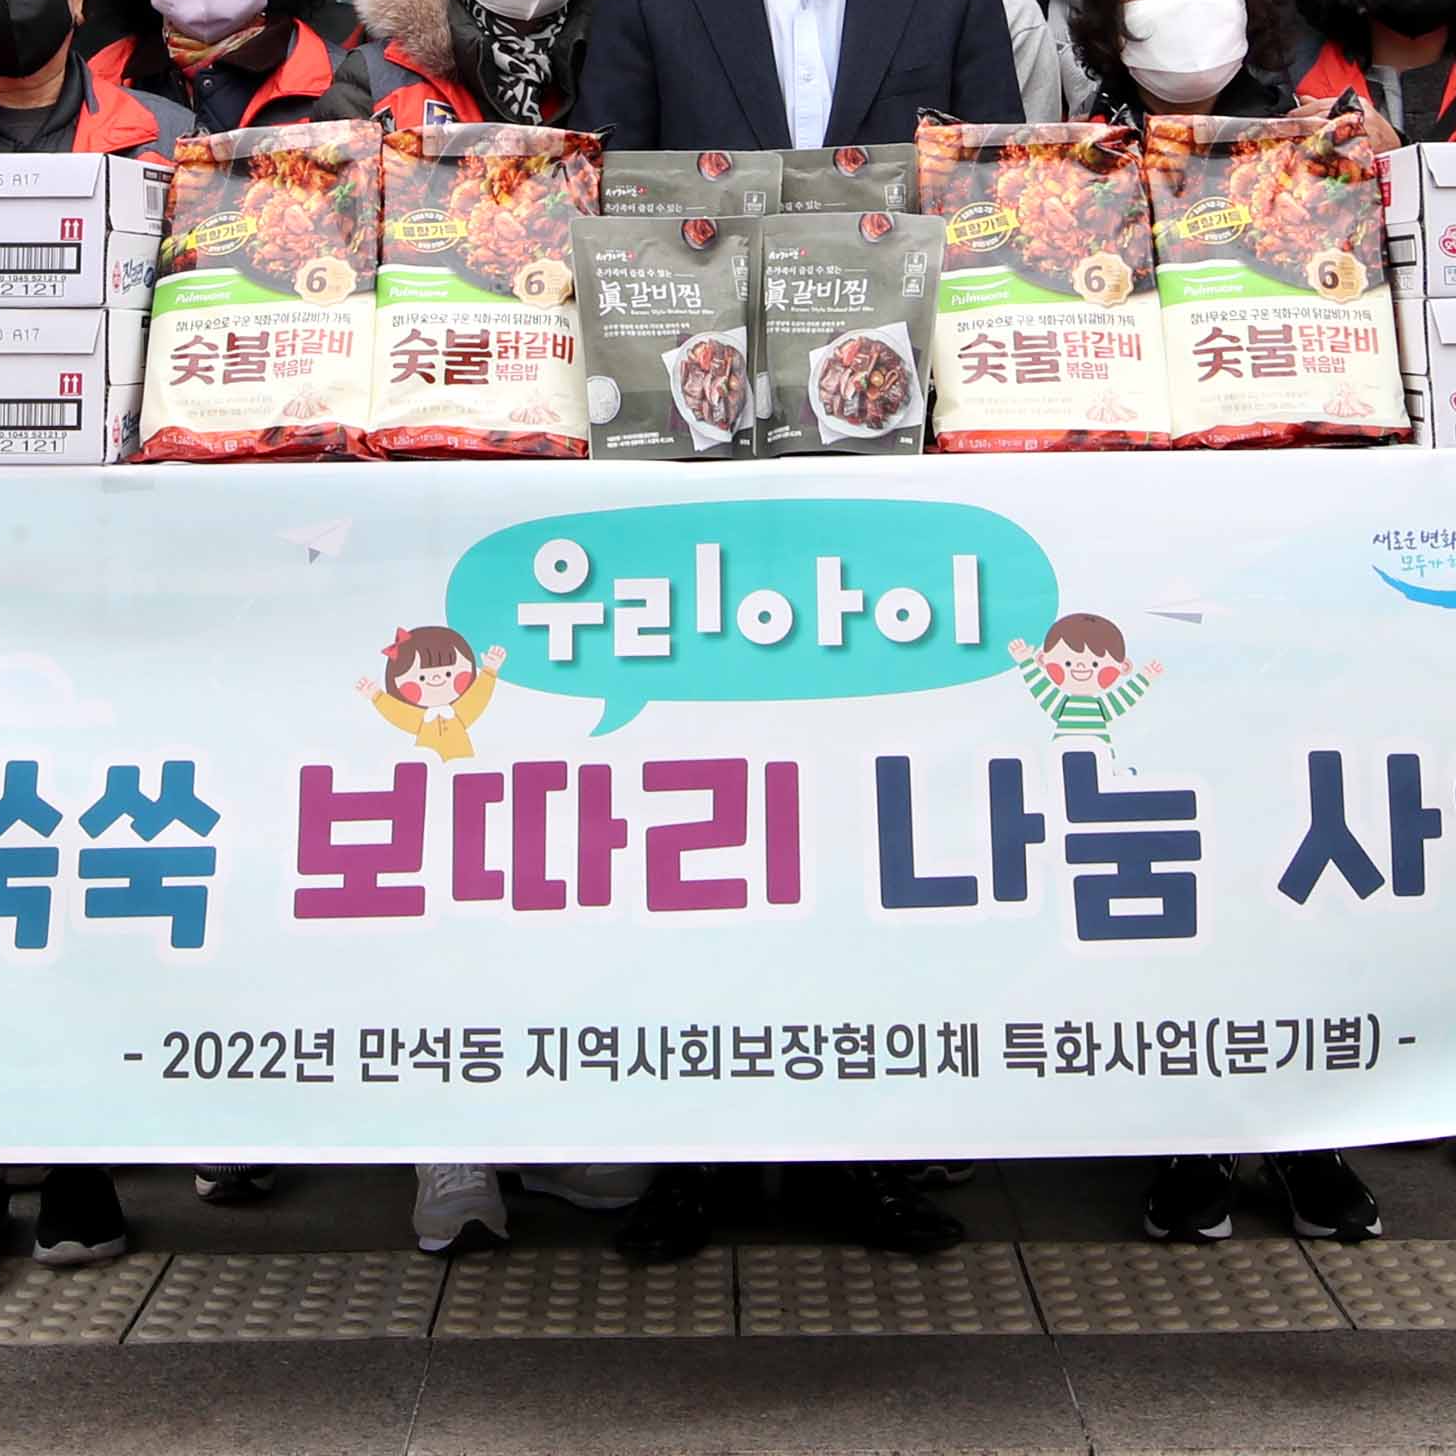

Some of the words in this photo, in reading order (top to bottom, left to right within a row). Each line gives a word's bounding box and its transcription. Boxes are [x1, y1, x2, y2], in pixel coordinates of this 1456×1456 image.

[306, 267, 327, 293] 6
[525, 270, 545, 295] 6
[1084, 265, 1105, 293] 6
[1318, 260, 1339, 289] 6
[169, 331, 271, 386] 숯불
[274, 328, 353, 358] 닭갈비
[389, 328, 493, 385] 숯불
[496, 330, 575, 365] 닭갈비
[957, 330, 1062, 385] 숯불
[1063, 330, 1142, 361] 닭갈비
[1192, 324, 1297, 382] 숯불
[1298, 324, 1379, 354] 닭갈비
[1302, 356, 1346, 374] 볶음밥
[272, 358, 314, 379] 볶음밥
[495, 363, 540, 381] 볶음밥
[1066, 361, 1109, 380] 볶음밥
[1372, 529, 1417, 550] 새로운
[1401, 553, 1443, 577] 모두가
[518, 539, 980, 661] 우리아이
[294, 758, 801, 918] 보따리
[876, 751, 1201, 941] 나눔
[163, 1028, 334, 1083] 2022년
[360, 1027, 505, 1083] 만석동
[527, 1021, 979, 1081] 지역사회보장협의체
[1002, 1013, 1382, 1078] 특화사업(분기별)
